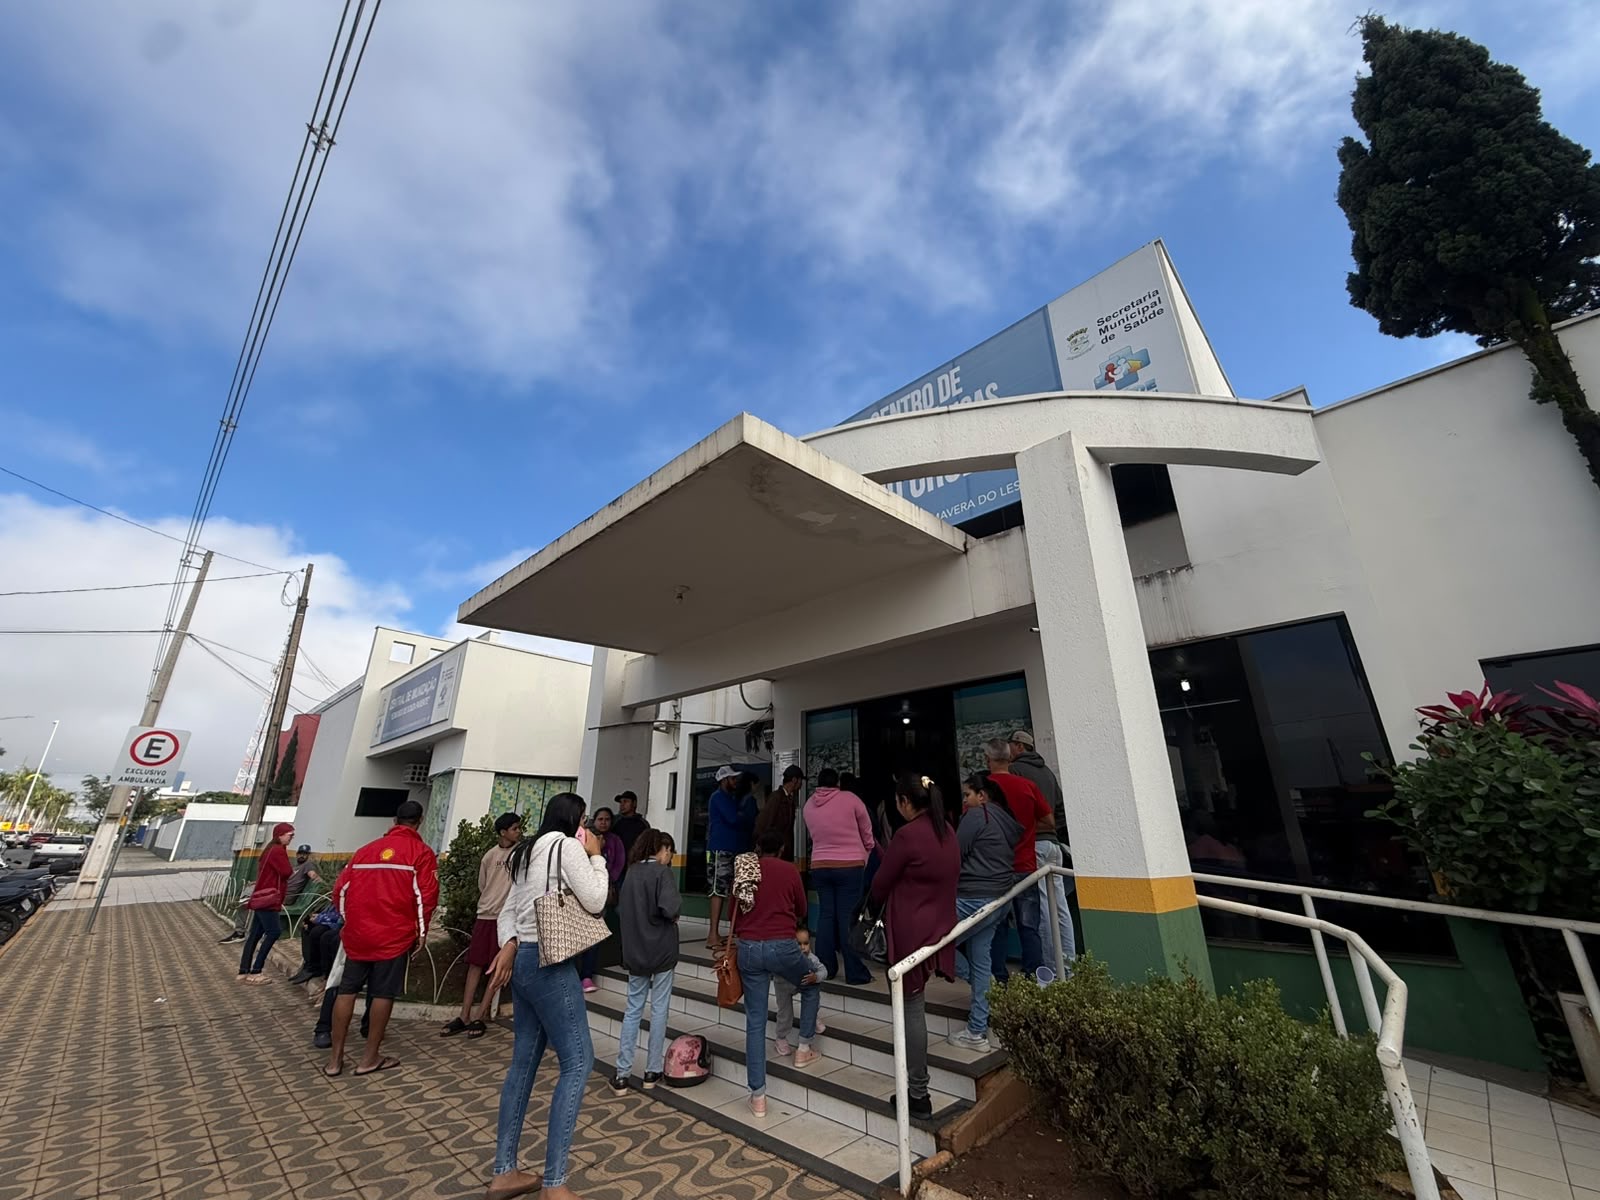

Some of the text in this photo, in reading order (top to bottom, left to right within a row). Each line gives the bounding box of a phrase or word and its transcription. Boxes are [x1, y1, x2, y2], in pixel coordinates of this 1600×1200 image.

[1096, 288, 1160, 327] Secretaria
[1098, 297, 1162, 336] Municipal
[1100, 307, 1165, 345] de Saúde
[937, 366, 963, 403] DE
[935, 480, 1021, 521] AVERA DO LES
[144, 738, 166, 759] E
[125, 768, 167, 776] EXCLUSIVO
